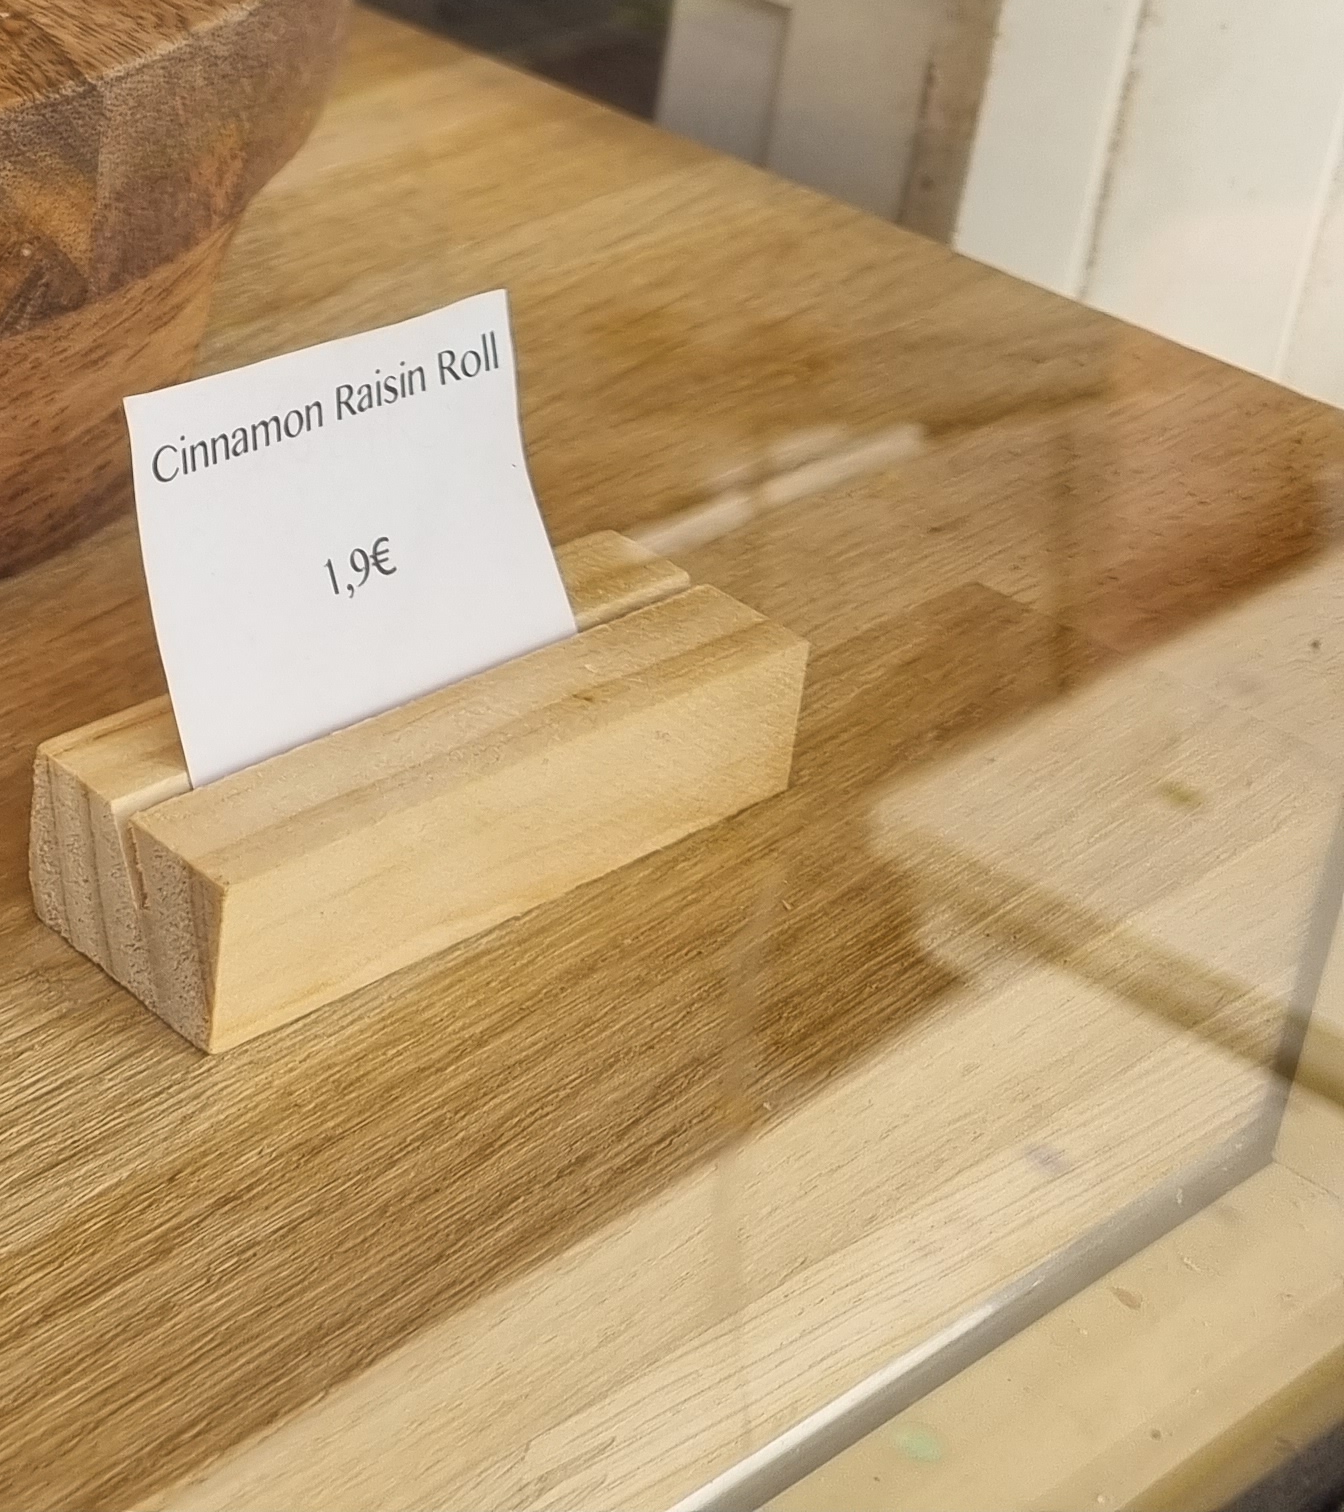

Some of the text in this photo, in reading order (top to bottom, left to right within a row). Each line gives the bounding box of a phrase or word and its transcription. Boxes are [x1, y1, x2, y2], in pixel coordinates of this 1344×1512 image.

[152, 330, 500, 483] Cinnamon Raisin Roll
[323, 536, 397, 598] 1,9€
